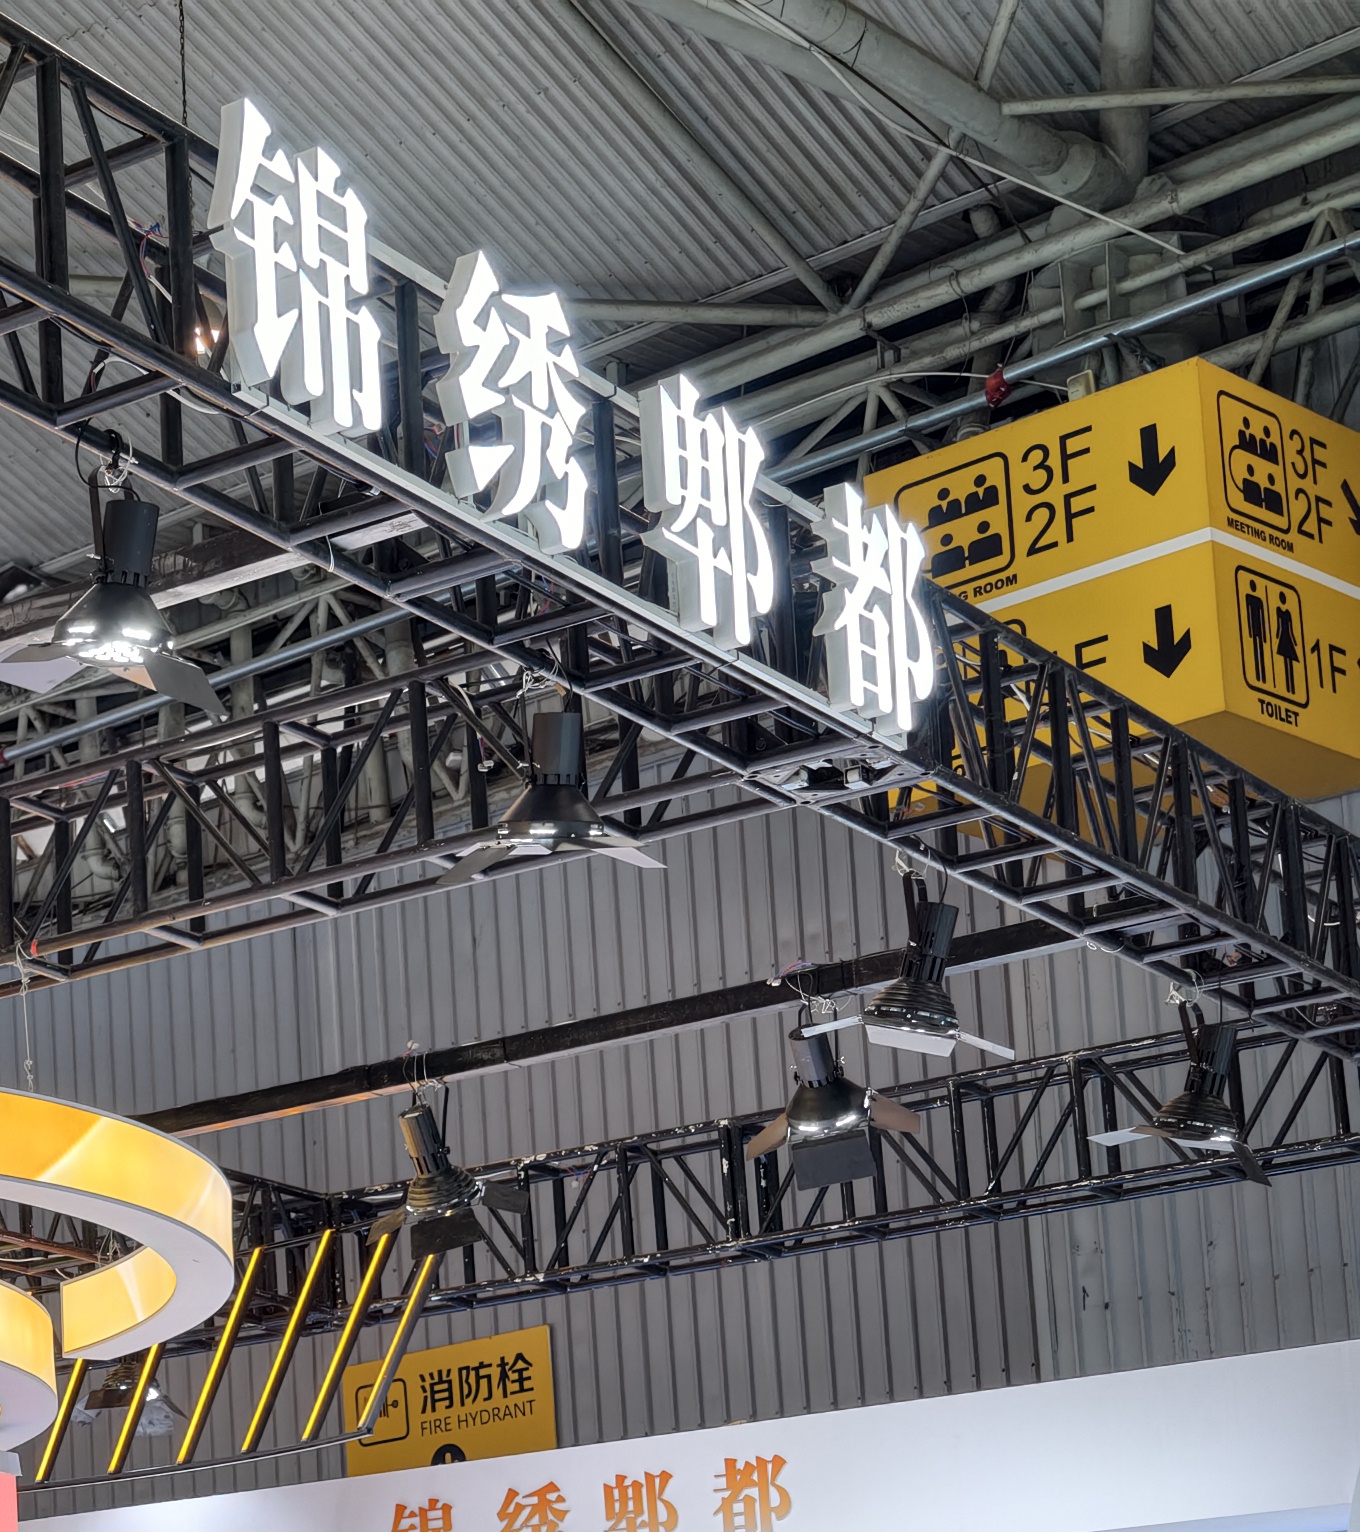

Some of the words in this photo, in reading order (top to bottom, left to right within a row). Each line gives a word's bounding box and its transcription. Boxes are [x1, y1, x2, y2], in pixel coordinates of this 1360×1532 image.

[212, 97, 936, 733] 锦绣郫都
[1020, 425, 1093, 495] 3F
[1289, 428, 1327, 482] 3F
[1025, 484, 1097, 557] 2F
[1226, 516, 1266, 547] MEETING
[1268, 531, 1295, 554] ROOM
[1294, 488, 1333, 544] 2F
[973, 573, 1018, 598] ROOM
[1310, 638, 1347, 695] 1F
[1258, 698, 1300, 728] TOILET
[418, 1352, 535, 1415] 消防栓
[421, 1416, 452, 1437] FIRE
[457, 1400, 536, 1430] HYDRANT
